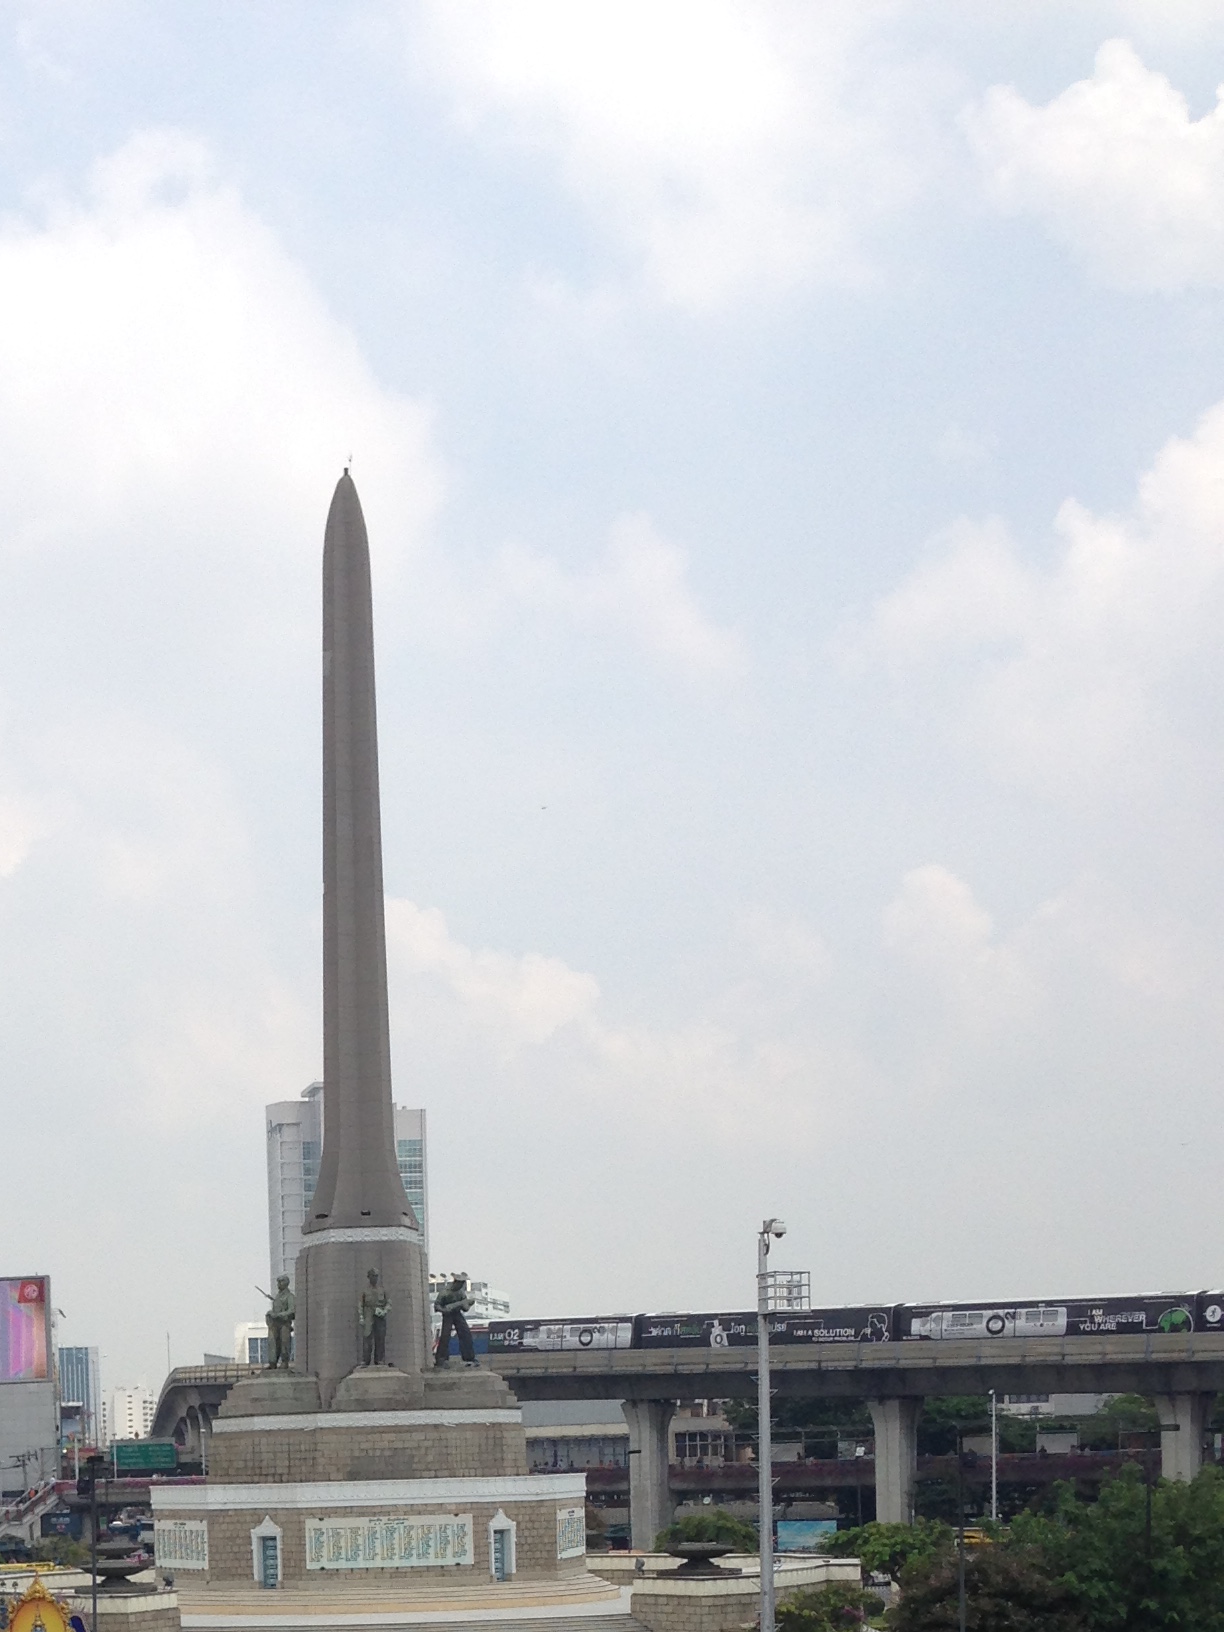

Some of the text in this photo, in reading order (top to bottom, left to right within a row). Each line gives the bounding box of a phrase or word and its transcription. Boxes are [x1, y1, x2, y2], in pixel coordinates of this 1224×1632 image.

[1093, 1314, 1146, 1324] WHEREVER
[1079, 1322, 1117, 1331] YOU ARE
[813, 1328, 855, 1337] SOLUTION
